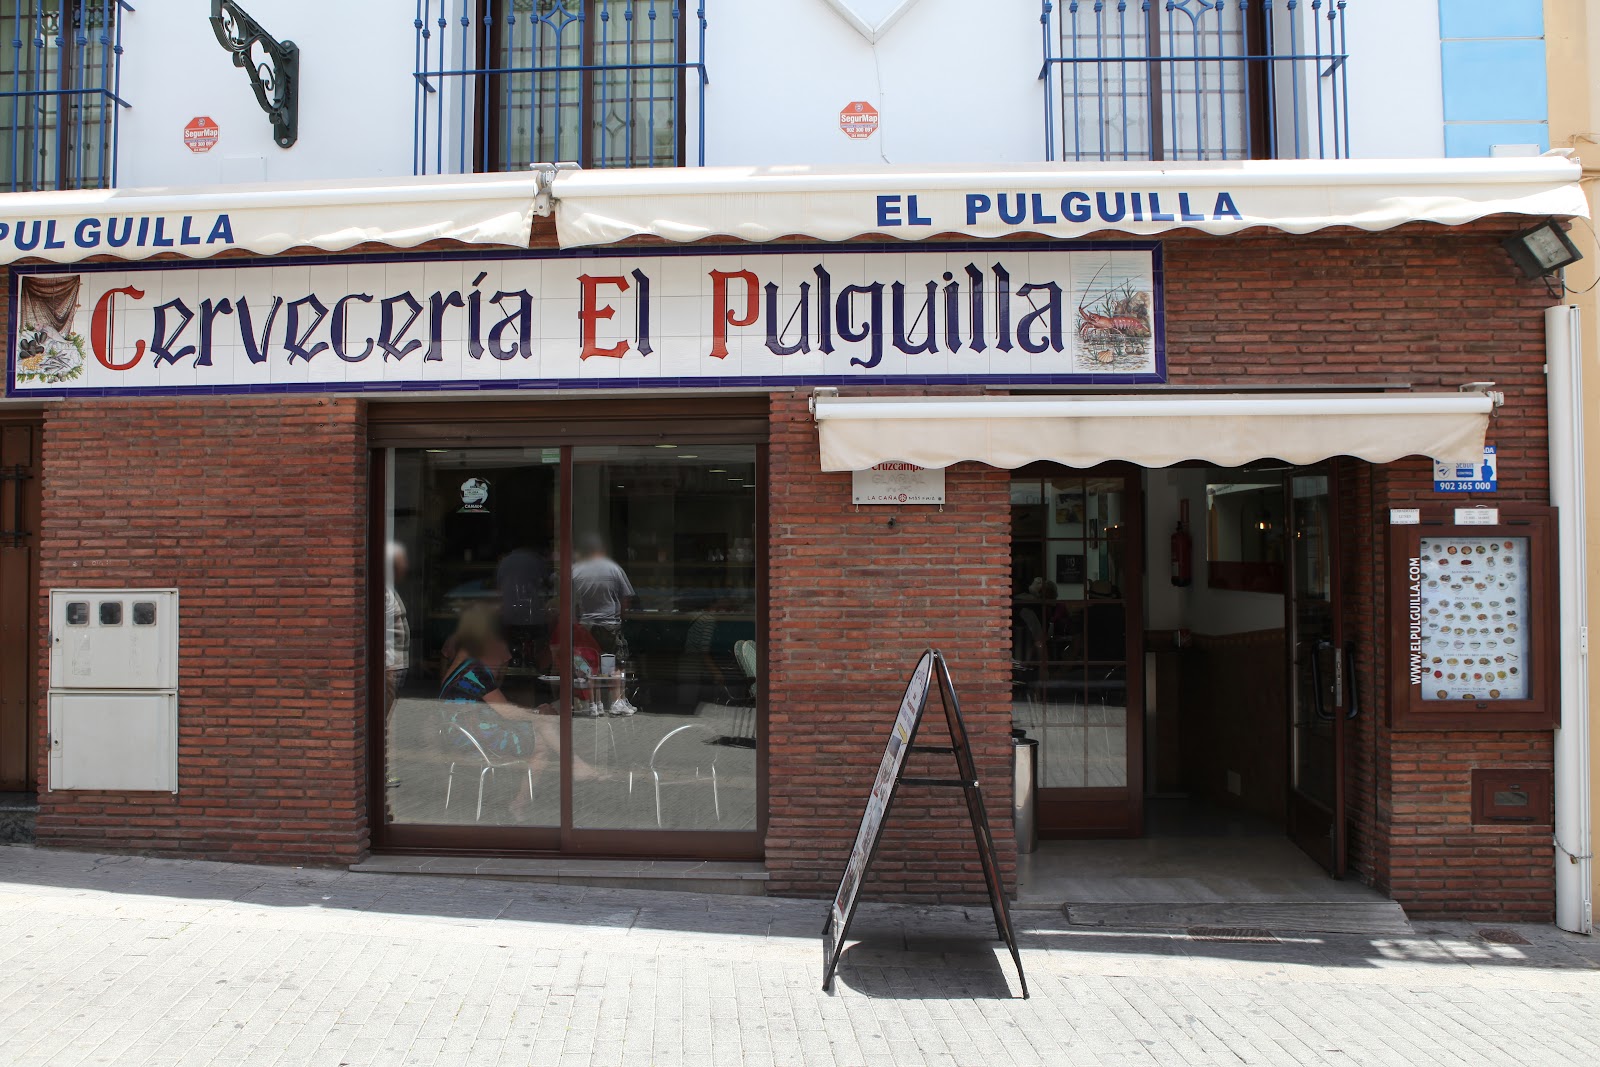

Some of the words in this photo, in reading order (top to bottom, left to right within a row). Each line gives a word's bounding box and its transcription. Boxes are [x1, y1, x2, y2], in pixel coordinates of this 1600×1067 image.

[841, 114, 877, 123] SegurMap
[185, 129, 217, 138] SegurMap
[876, 194, 932, 227] EL
[965, 191, 1244, 226] PULGUILLA
[90, 271, 534, 371] Cervecería
[576, 267, 654, 362] El
[708, 261, 1066, 369] Pulguilla
[1440, 482, 1456, 490] 902
[1457, 482, 1473, 490] 365
[1474, 482, 1491, 490] 000
[1409, 557, 1421, 685] WWW.ELPULGUILLA.COM
